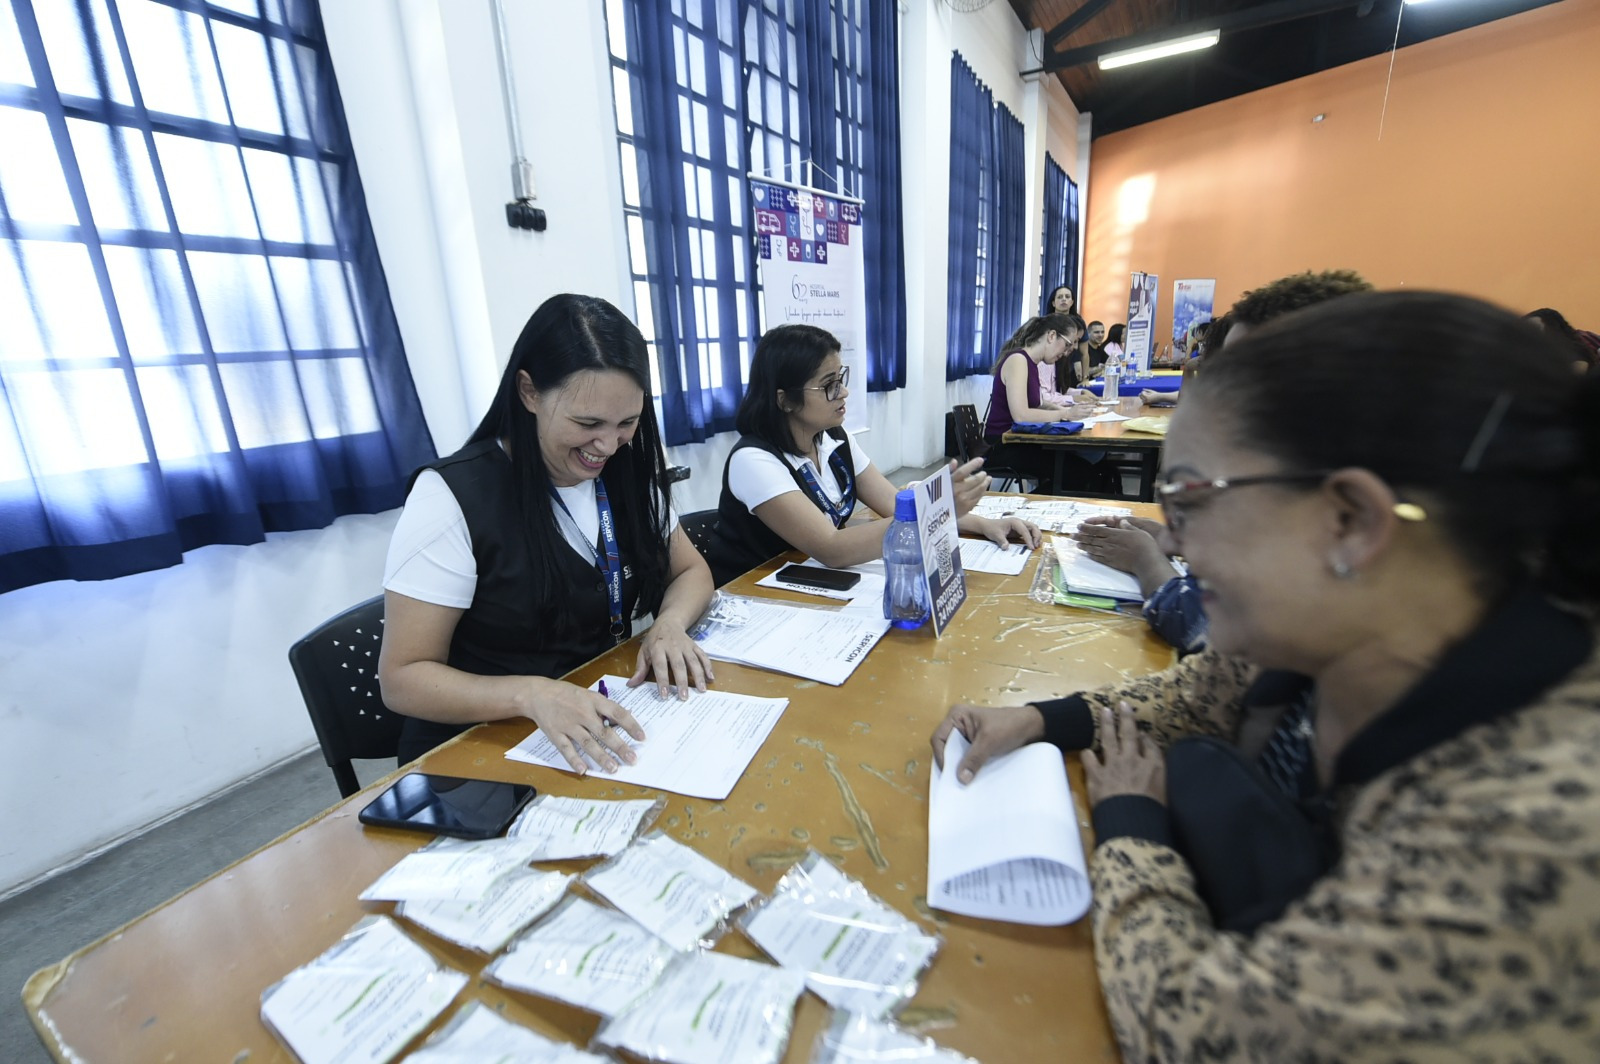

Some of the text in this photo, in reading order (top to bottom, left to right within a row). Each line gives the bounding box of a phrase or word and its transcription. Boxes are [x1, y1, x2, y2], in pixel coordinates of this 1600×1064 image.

[810, 290, 826, 298] STELLA
[601, 510, 613, 542] SERVCON
[927, 508, 951, 537] SERVCON
[935, 573, 962, 610] PROTEGIDO
[938, 587, 964, 627] 24 HORAS
[844, 634, 874, 663] SERVCON
